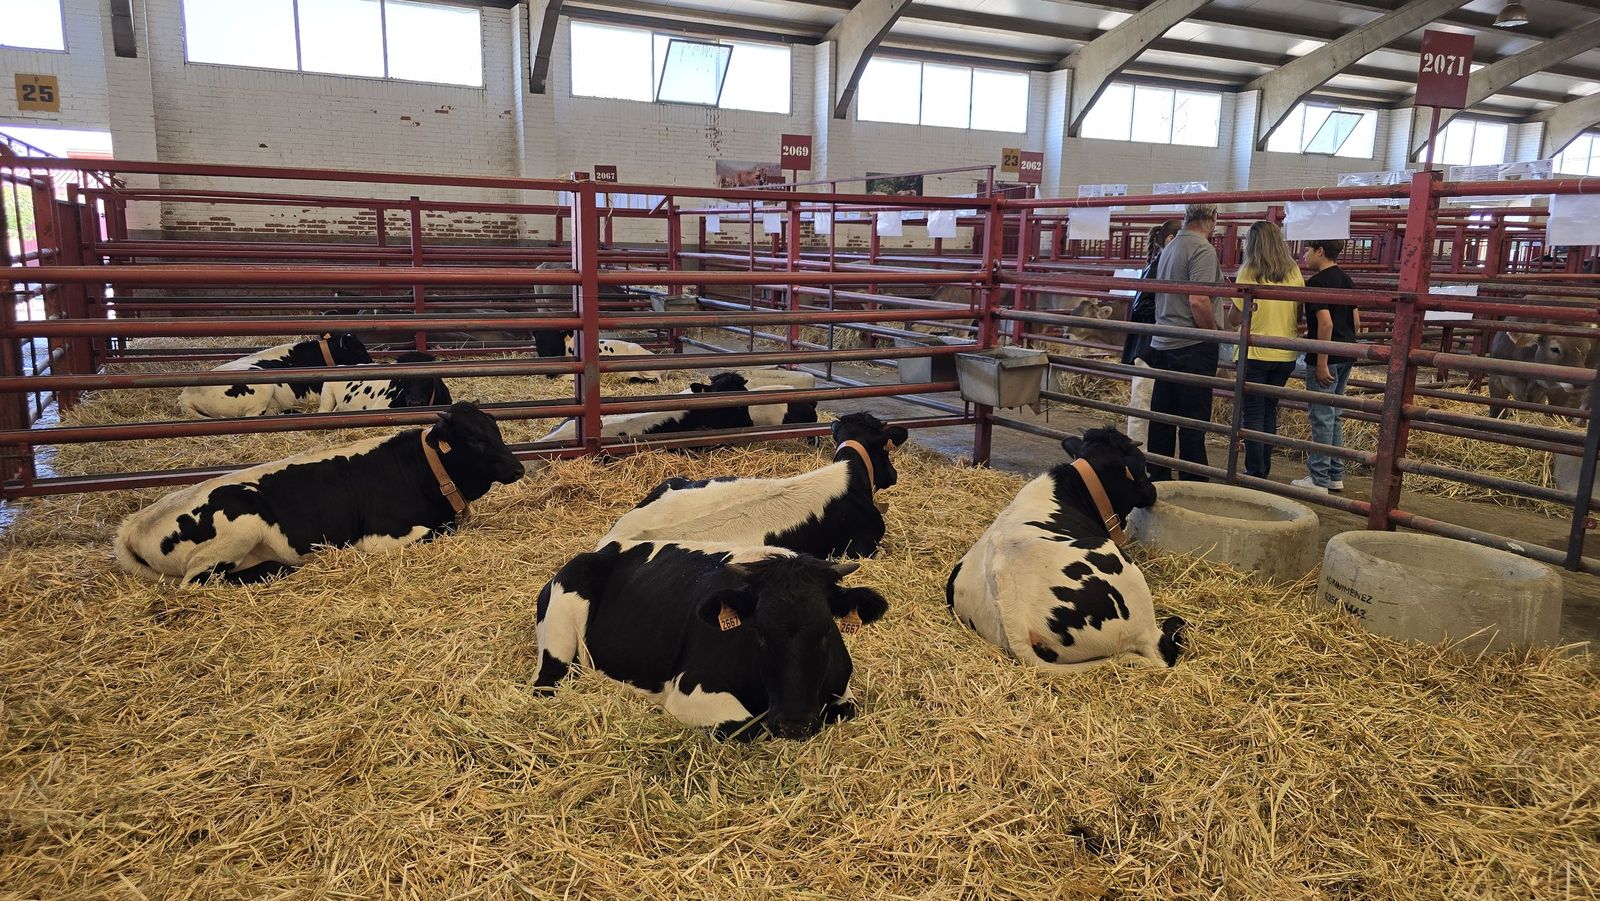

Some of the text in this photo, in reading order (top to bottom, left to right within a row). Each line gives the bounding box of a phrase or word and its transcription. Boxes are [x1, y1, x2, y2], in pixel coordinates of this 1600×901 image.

[1422, 52, 1465, 76] 2071
[22, 84, 54, 102] 25
[782, 145, 809, 157] 2069
[1004, 155, 1019, 166] 23
[1020, 160, 1042, 171] 2062
[596, 172, 616, 180] 2067
[721, 616, 739, 630] 2667
[840, 623, 860, 635] 2667
